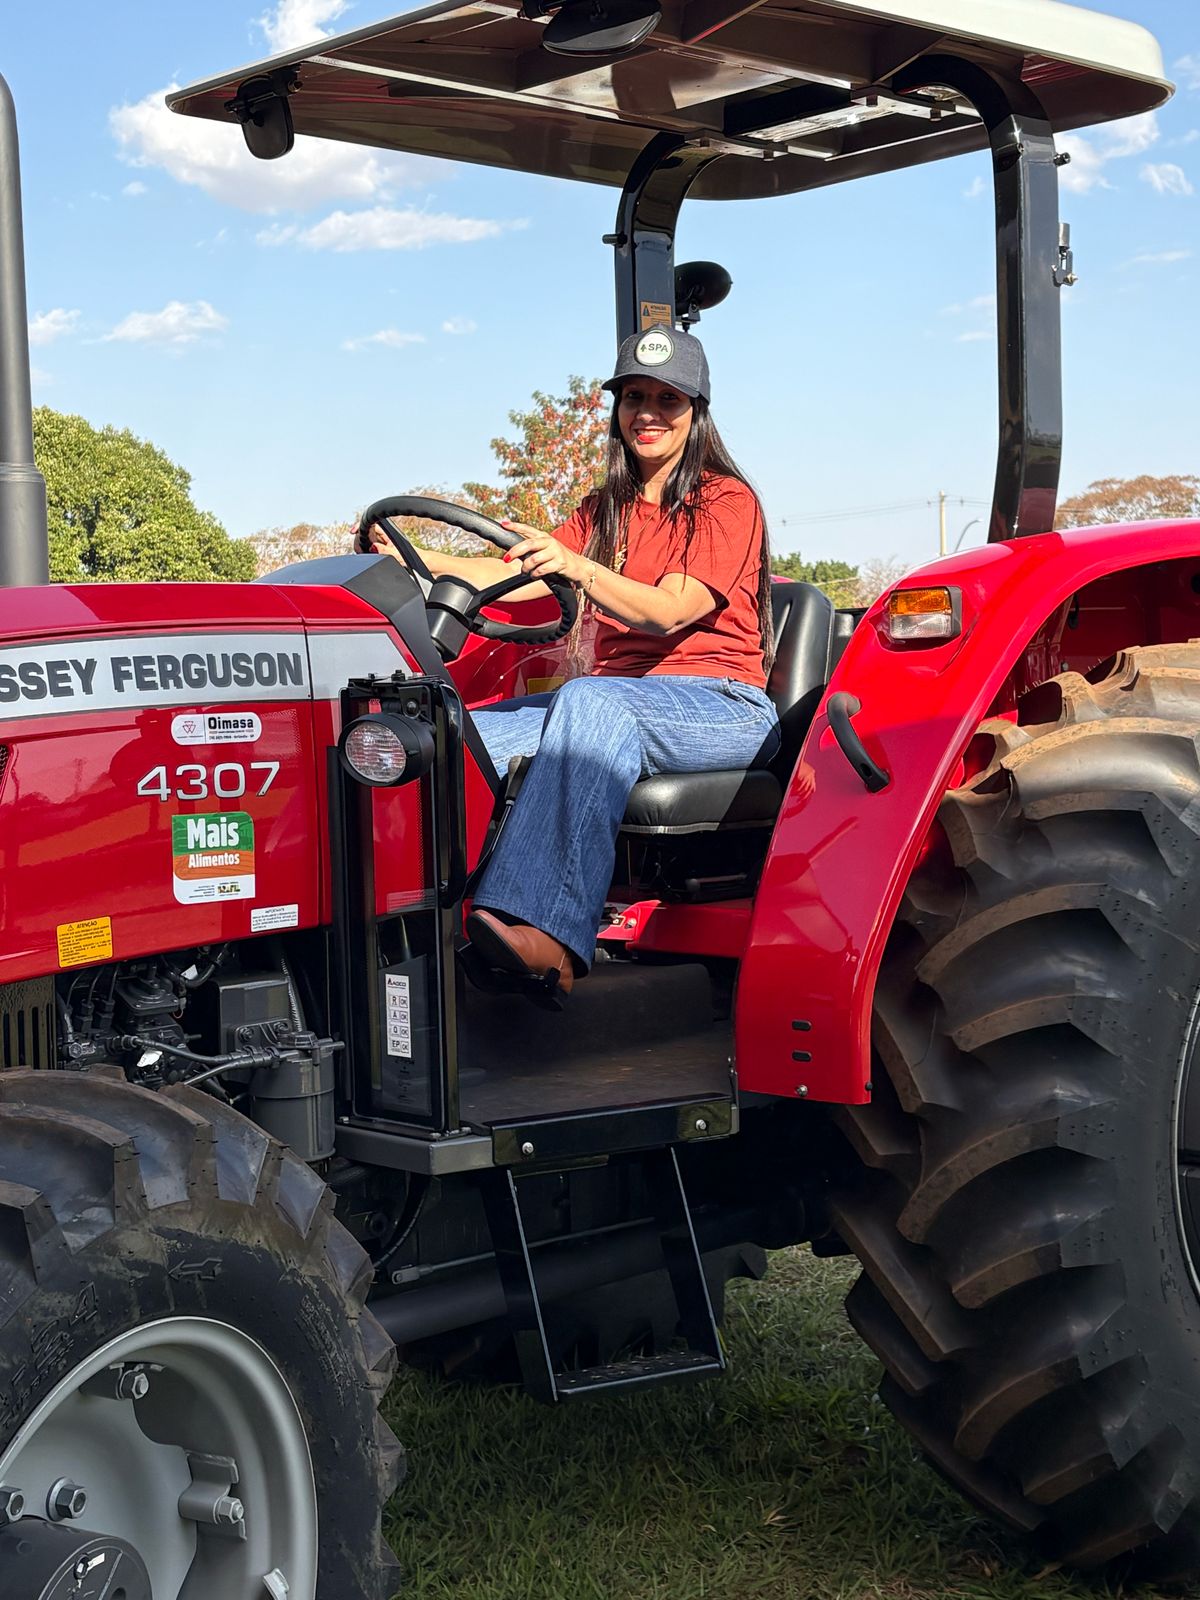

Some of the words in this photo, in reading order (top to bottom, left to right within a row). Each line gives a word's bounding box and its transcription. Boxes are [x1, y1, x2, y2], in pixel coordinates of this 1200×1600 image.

[648, 343, 668, 352] SPA
[110, 652, 304, 691] FERGUSON
[208, 717, 254, 730] Oimasa
[136, 761, 280, 802] 4307
[186, 817, 240, 849] Mais
[188, 852, 240, 868] Alimentos
[392, 1040, 400, 1048] EP
